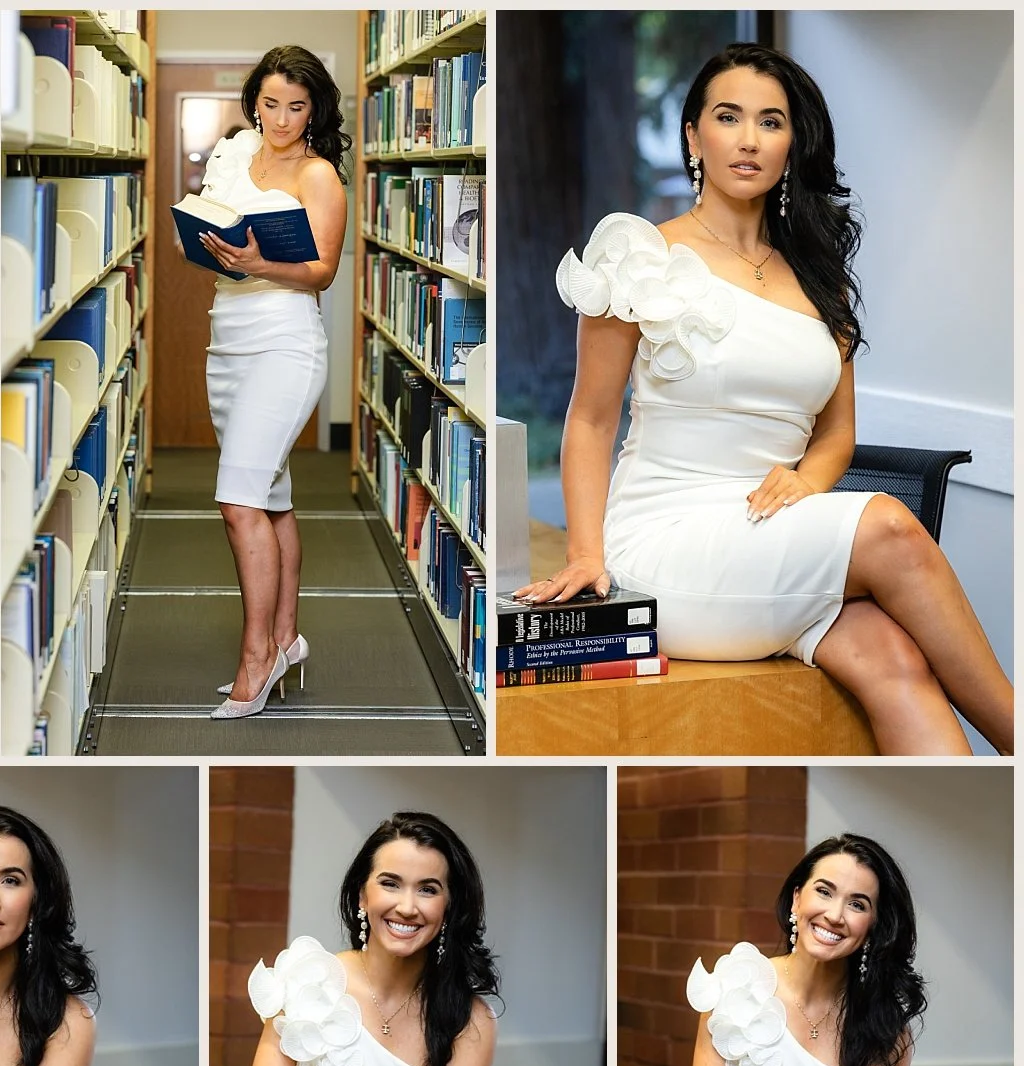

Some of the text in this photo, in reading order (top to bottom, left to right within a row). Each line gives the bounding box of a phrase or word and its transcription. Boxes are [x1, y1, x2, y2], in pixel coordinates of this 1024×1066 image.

[527, 614, 542, 640] History
[526, 637, 626, 652] PROFESSIONAL RESPONSIBILITY
